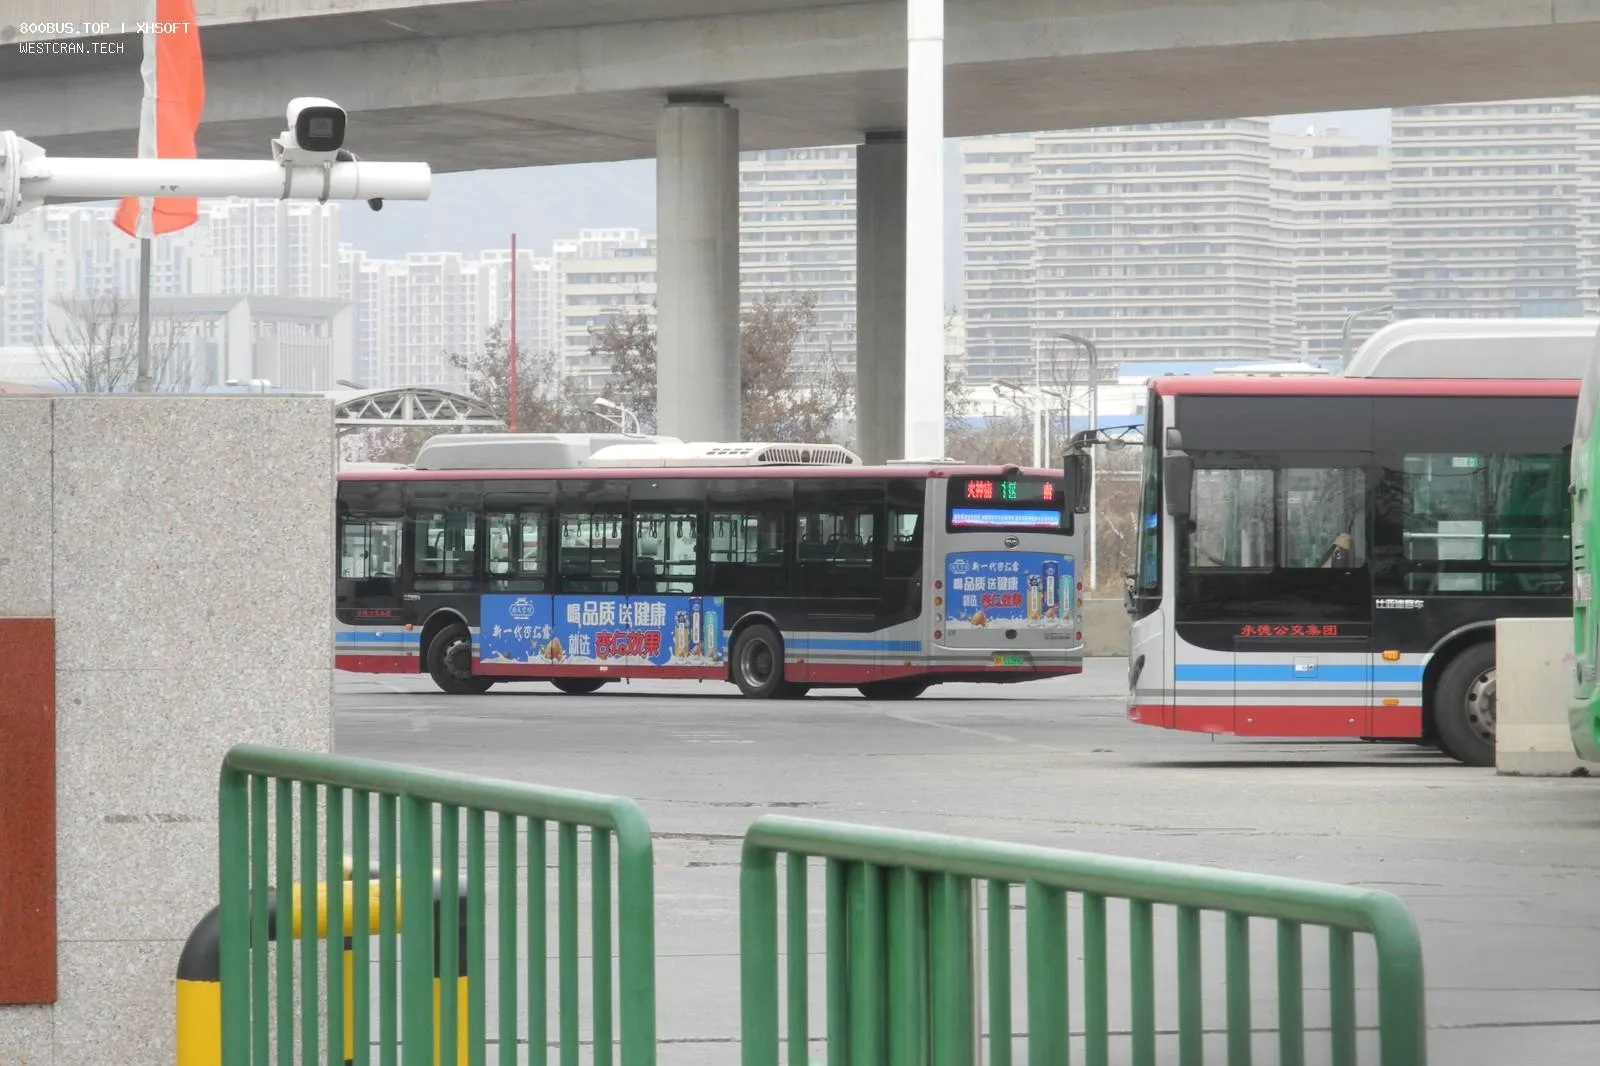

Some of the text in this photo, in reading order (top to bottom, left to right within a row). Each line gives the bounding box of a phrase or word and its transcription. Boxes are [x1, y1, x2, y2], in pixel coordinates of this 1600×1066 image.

[1240, 624, 1338, 636] 承德公交集团
